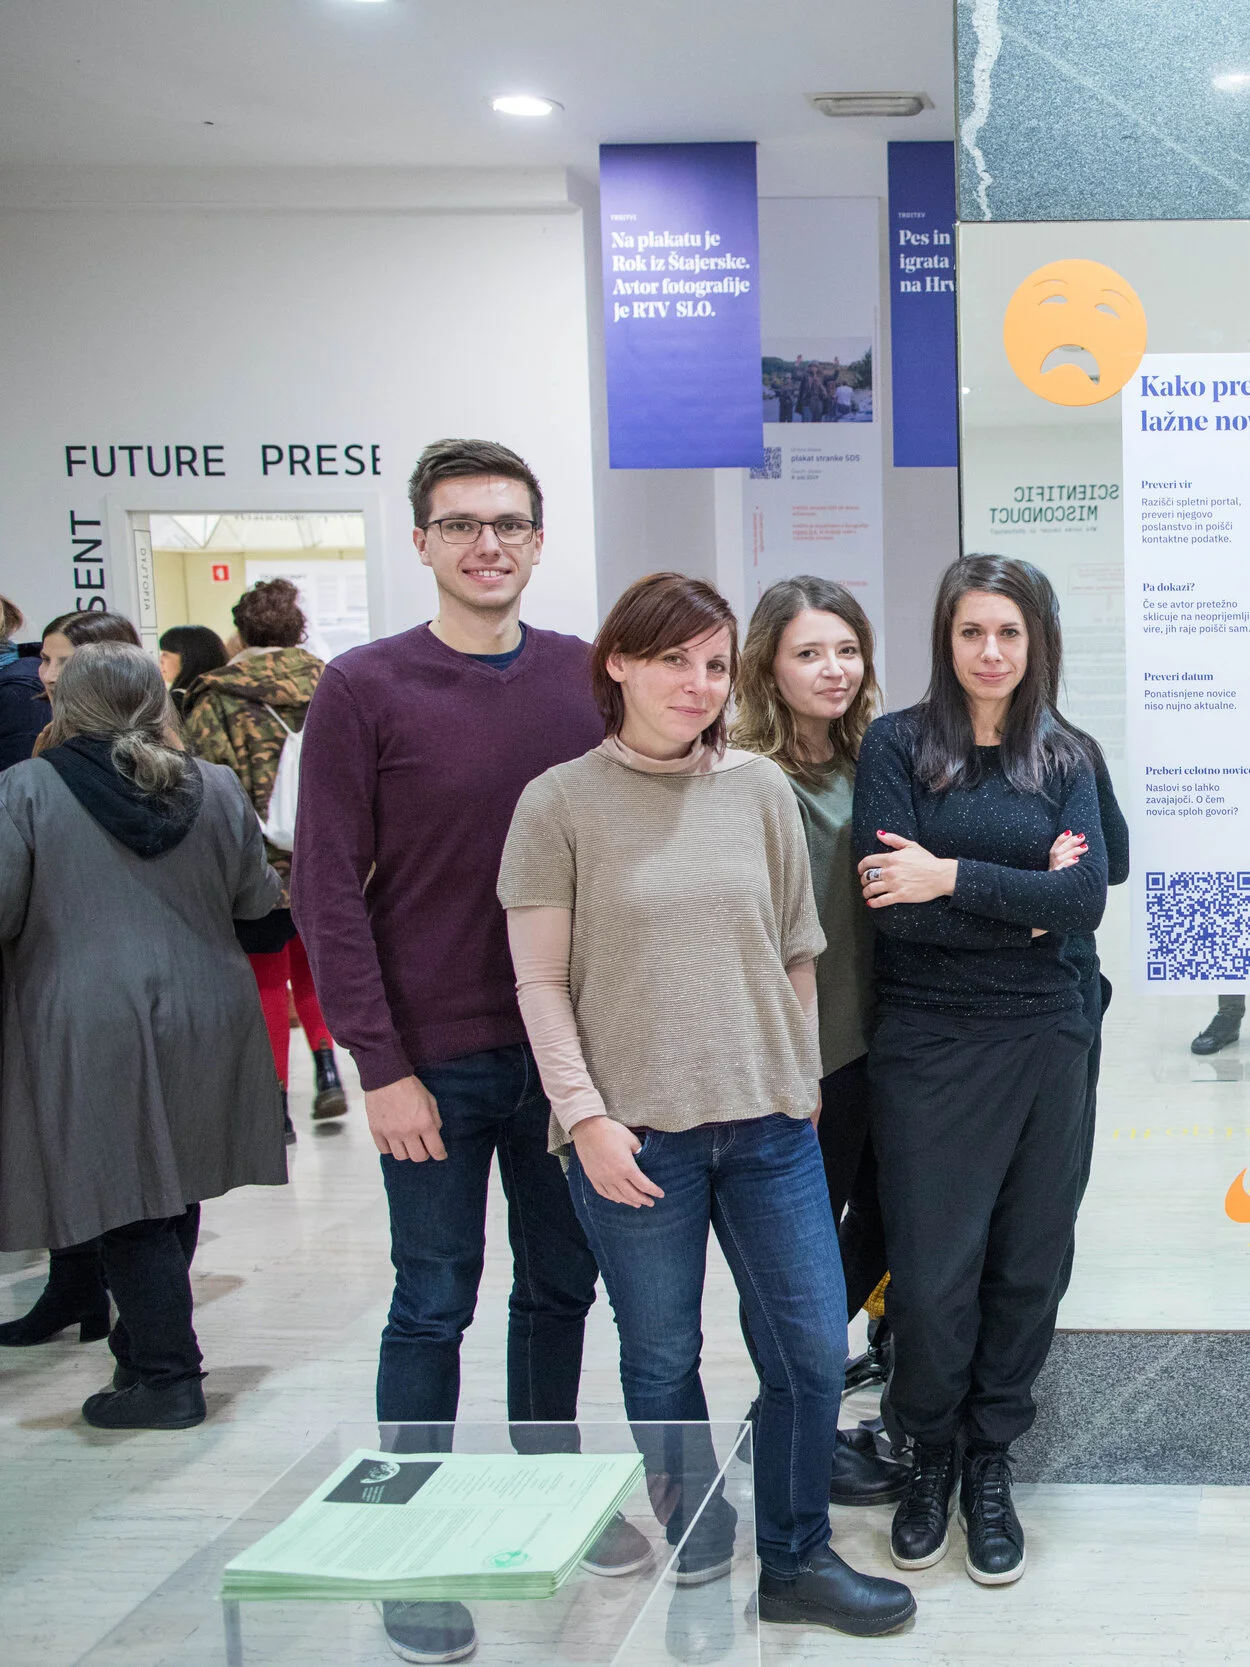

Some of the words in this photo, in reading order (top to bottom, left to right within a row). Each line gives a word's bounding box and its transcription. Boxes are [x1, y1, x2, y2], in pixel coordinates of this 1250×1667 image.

[612, 232, 634, 248] Na
[638, 231, 701, 252] plakatu
[705, 231, 720, 251] je
[899, 229, 929, 245] Pes
[933, 229, 950, 245] in
[612, 255, 647, 271] Rok
[651, 254, 665, 270] iz
[669, 251, 750, 274] Štajerske.
[900, 254, 949, 273] igrata
[613, 278, 659, 295] Avtor
[662, 277, 750, 298] fotografije
[901, 280, 921, 292] na
[614, 302, 630, 322] je
[633, 301, 669, 318] RTV
[676, 301, 716, 317] SLO.
[1140, 375, 1206, 397] Kako
[1140, 410, 1209, 432] lažne
[65, 445, 226, 477] FUTURE
[791, 455, 814, 463] plakat
[1142, 480, 1177, 489] Preveri
[1179, 480, 1192, 488] vir
[1141, 497, 1174, 507] Razišči
[1176, 497, 1209, 508] spletni
[1210, 497, 1242, 508] portal,
[1141, 510, 1174, 521] preveri
[1176, 510, 1213, 521] njegovo
[1141, 521, 1192, 533] poslanstvo
[1195, 522, 1203, 531] in
[1205, 521, 1233, 533] poišči
[1142, 535, 1188, 543] kontaktne
[1191, 534, 1231, 545] podatke.
[140, 548, 151, 611] DYSTOPIA
[1143, 583, 1155, 592] Pa
[1157, 582, 1195, 591] dokazi?
[1144, 672, 1179, 681] Preveri
[1181, 672, 1213, 681] datum
[1144, 689, 1204, 699] Ponatisnjene
[1206, 689, 1236, 697] novice
[1145, 701, 1164, 710] niso
[1166, 701, 1192, 712] nujno
[1194, 701, 1236, 710] aktualne.
[1146, 766, 1182, 775] Preberi
[1184, 766, 1220, 775] celotno
[1146, 783, 1179, 792] Naslovi
[1194, 783, 1220, 791] lahko
[1146, 795, 1193, 805] zavajajoči.
[1196, 795, 1203, 804] O
[1205, 795, 1224, 803] čem
[1146, 807, 1177, 816] novica
[1178, 807, 1203, 817] sploh
[1206, 807, 1238, 817] govori?
